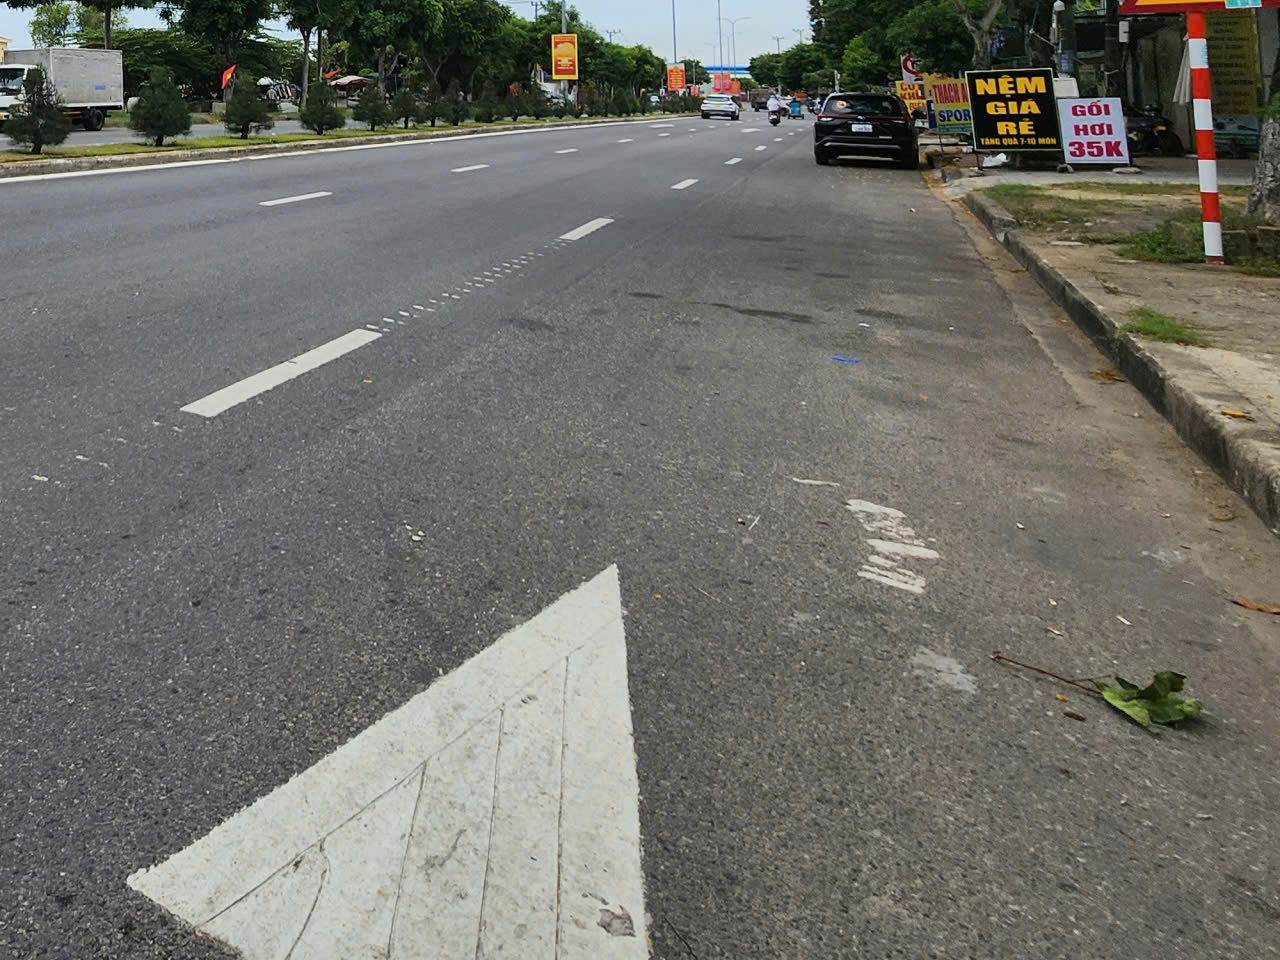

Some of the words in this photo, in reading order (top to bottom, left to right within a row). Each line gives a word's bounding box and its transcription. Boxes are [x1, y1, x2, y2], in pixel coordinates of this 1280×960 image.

[975, 74, 1047, 98] NỆM
[986, 98, 1041, 115] GIÁ
[1071, 99, 1111, 117] GỐI
[996, 117, 1037, 135] RẺ
[1073, 123, 1113, 136] HƠI
[1068, 141, 1124, 158] 35K
